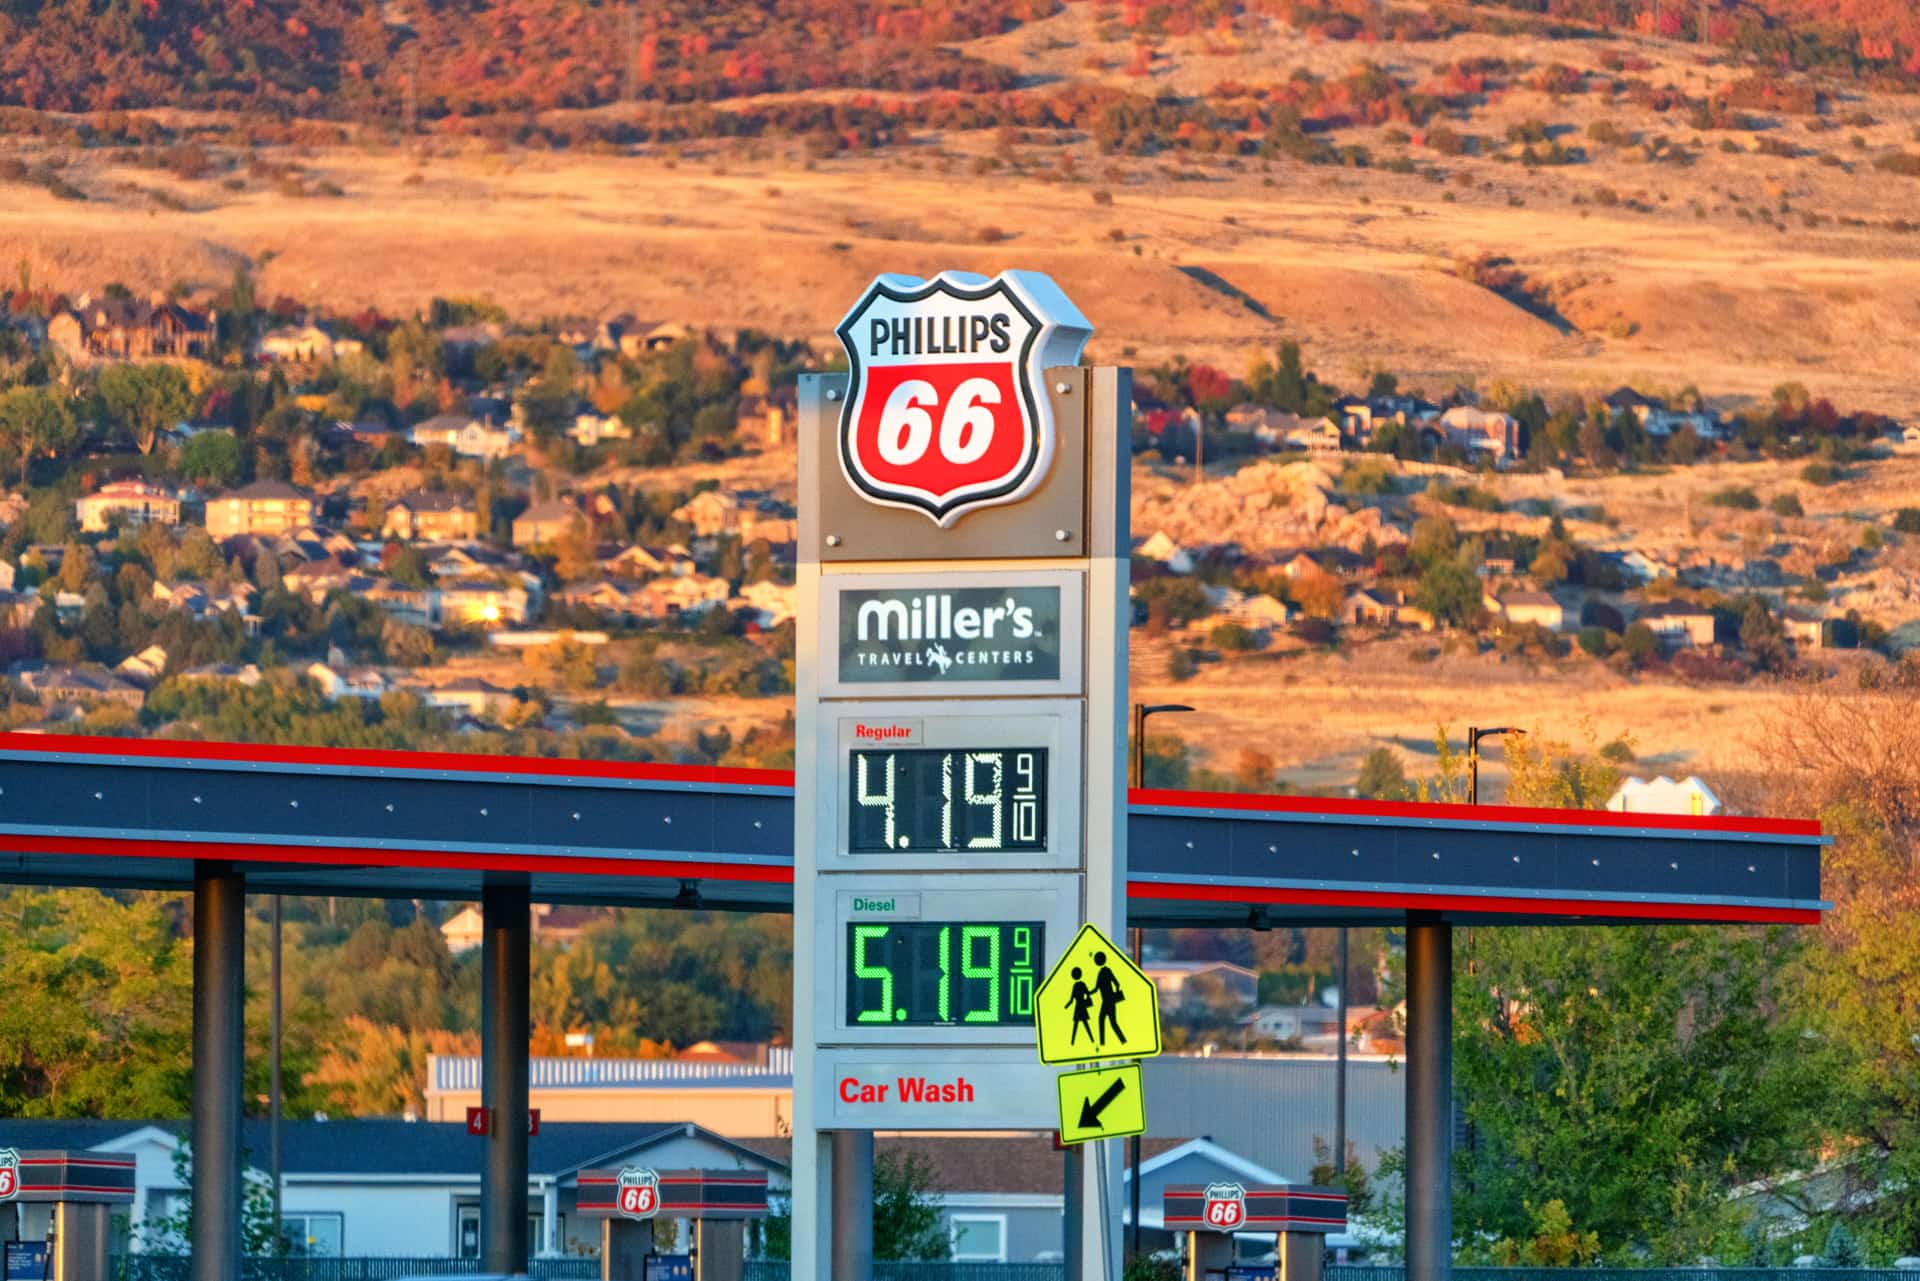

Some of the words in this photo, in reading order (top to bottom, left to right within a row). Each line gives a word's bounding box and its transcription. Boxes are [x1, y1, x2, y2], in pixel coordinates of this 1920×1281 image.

[870, 313, 1011, 356] PHILLIPS
[877, 377, 1002, 466] 66
[858, 652, 923, 665] TRAVEL
[956, 650, 1033, 664] CENTERS
[855, 724, 912, 741] Regular
[853, 898, 895, 911] Diesel
[839, 1077, 889, 1103] Car
[897, 1077, 974, 1103] Wash
[473, 1112, 482, 1130] 4
[623, 1175, 652, 1185] PHILLIPS
[625, 1188, 652, 1210] 66
[1211, 1203, 1238, 1223] 66
